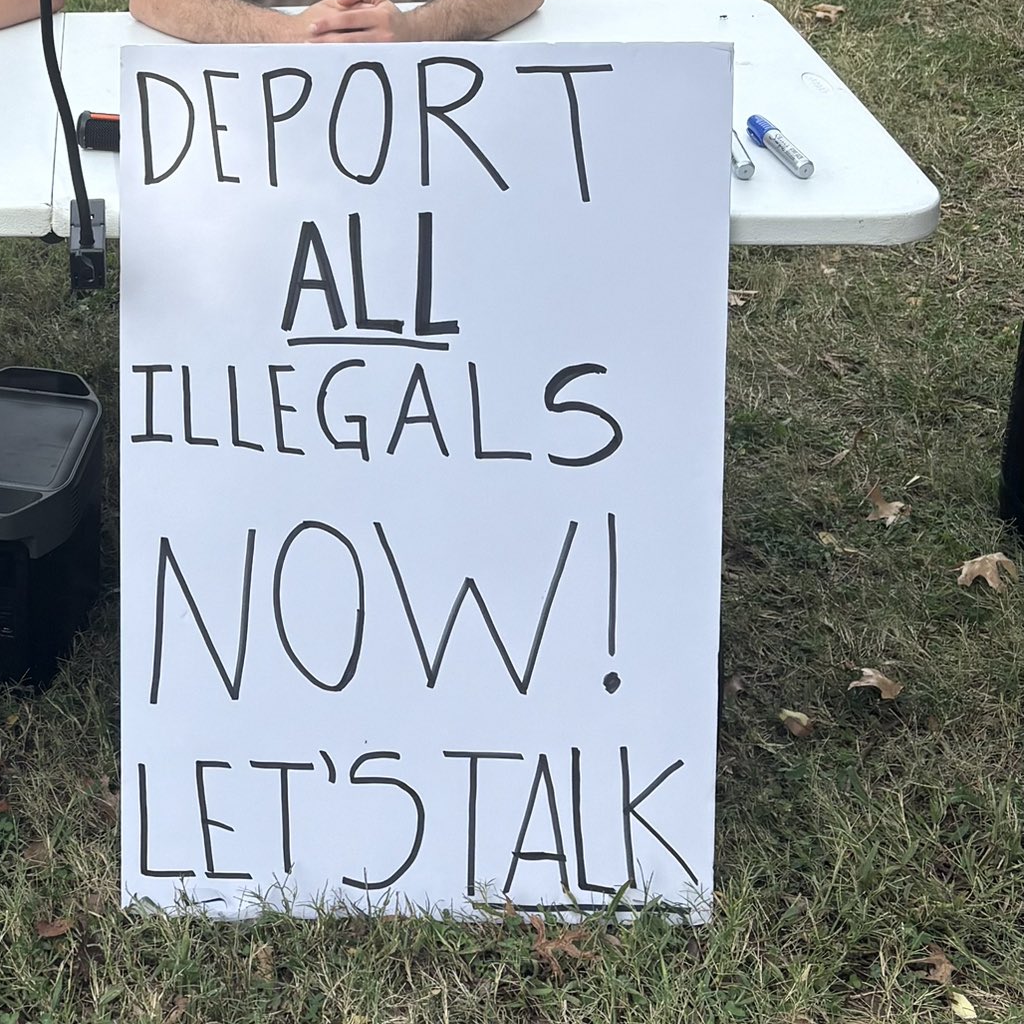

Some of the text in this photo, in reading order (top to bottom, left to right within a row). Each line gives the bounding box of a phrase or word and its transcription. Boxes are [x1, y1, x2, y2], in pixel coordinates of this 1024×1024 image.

[136, 56, 614, 203] DEPORT
[281, 211, 460, 336] ALL
[130, 358, 624, 468] ILLEGALS
[148, 512, 622, 705] NOW!
[137, 746, 699, 897] LET'S TALK
